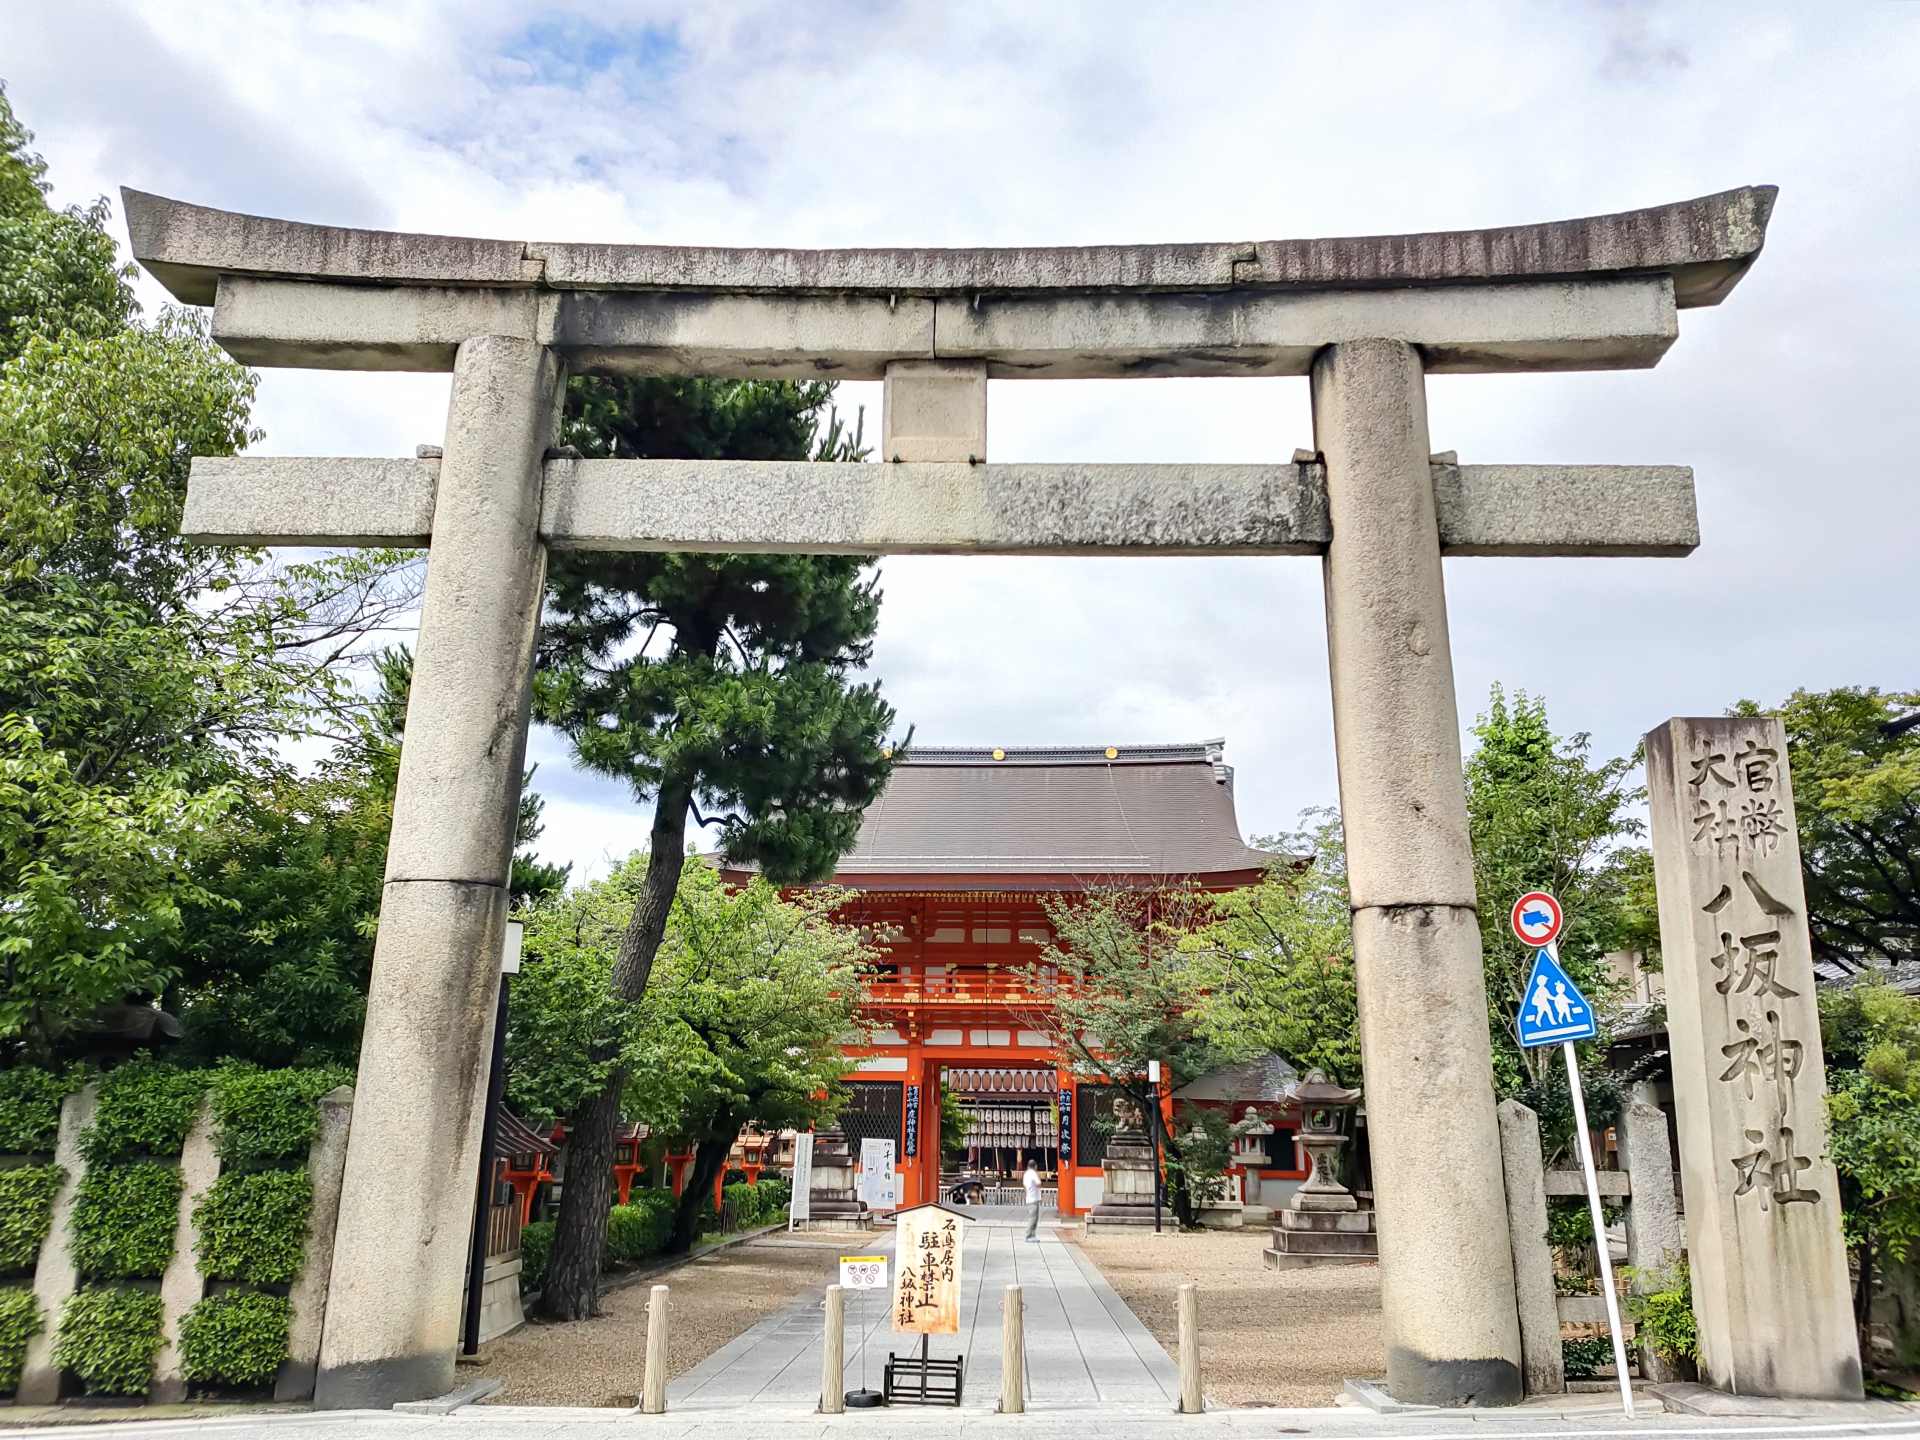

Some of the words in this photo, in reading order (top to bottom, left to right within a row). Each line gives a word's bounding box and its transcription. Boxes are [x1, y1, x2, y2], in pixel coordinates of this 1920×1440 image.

[1688, 740, 1739, 856] 大社
[1733, 740, 1789, 857] 官幣
[1702, 870, 1821, 1212] 八坂神社
[1060, 1115, 1071, 1154] 月次祭
[915, 1231, 941, 1309] 駐車禁止
[940, 1218, 957, 1282] 石鳥居内
[898, 1266, 917, 1327] 八坂神社
